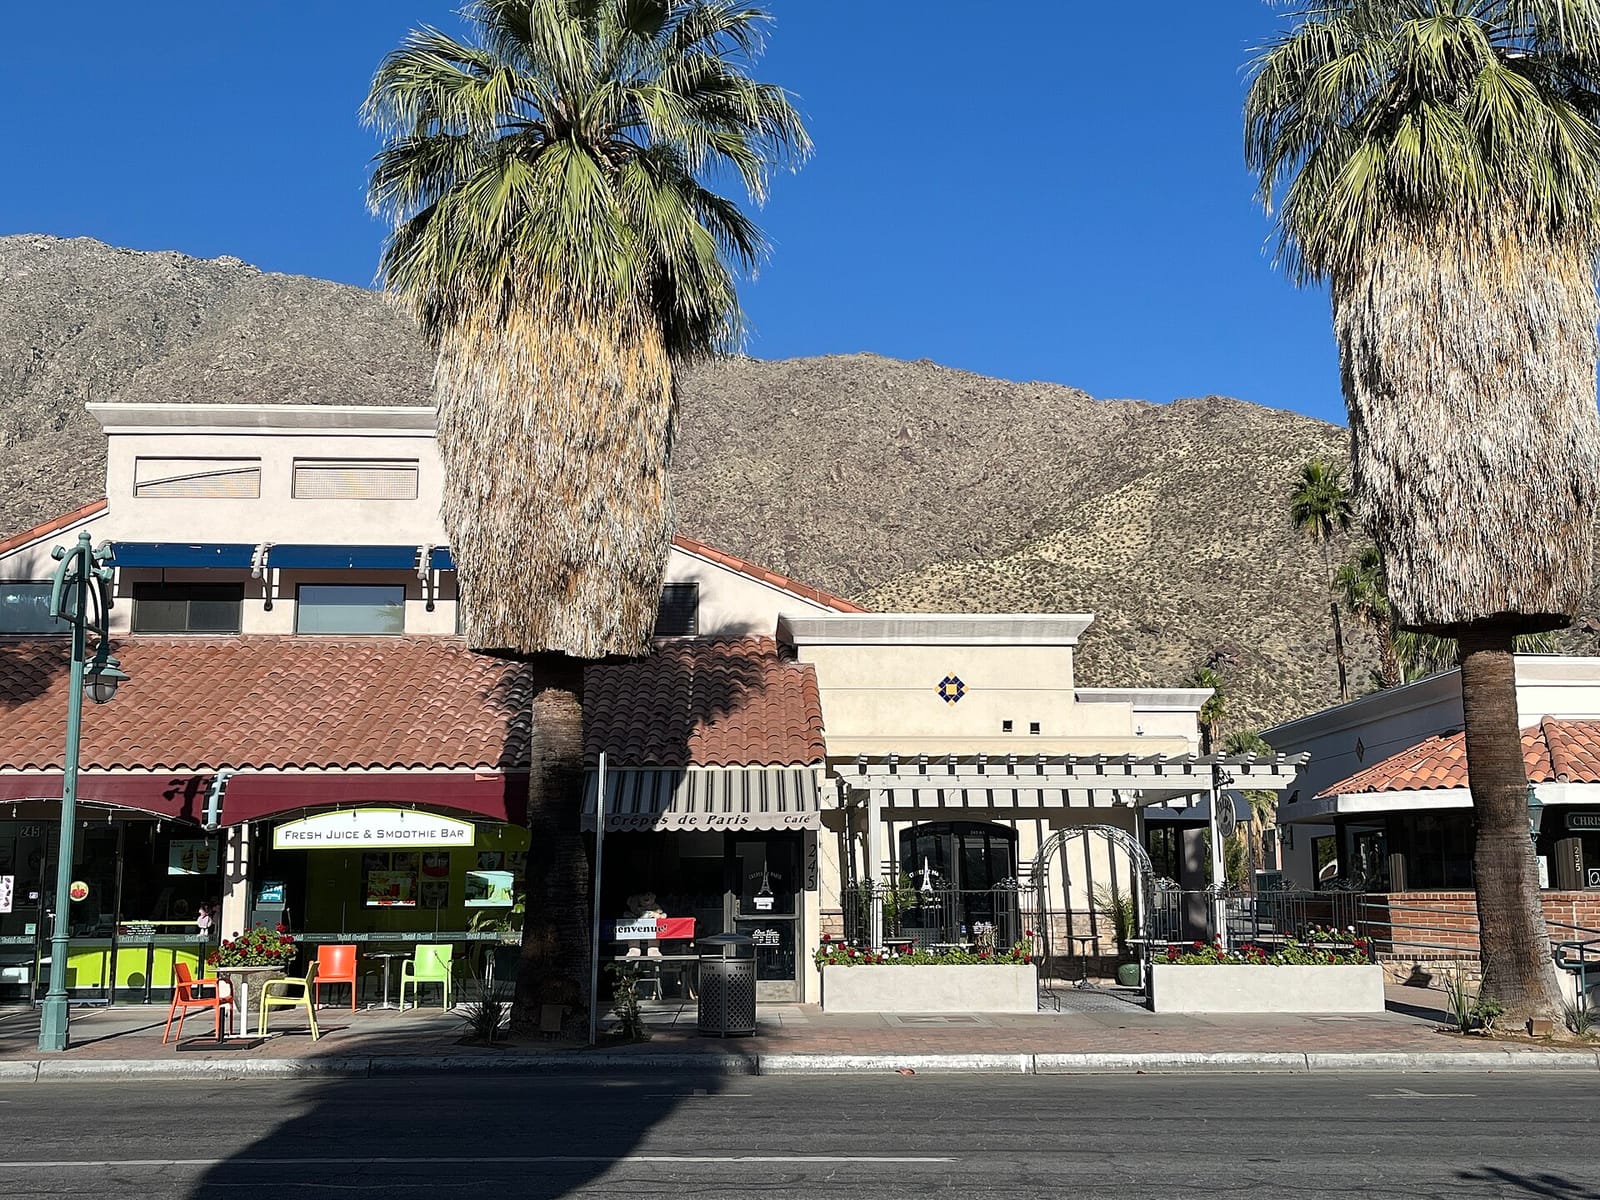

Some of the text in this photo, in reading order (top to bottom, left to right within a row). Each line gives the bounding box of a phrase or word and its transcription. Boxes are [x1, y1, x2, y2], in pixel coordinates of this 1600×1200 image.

[678, 815, 697, 824] de
[707, 815, 750, 825] Paris
[784, 815, 811, 824] Café
[285, 828, 464, 840] FRESH JUICE & SMOOTHIE BAR
[1574, 846, 1582, 872] 235
[808, 844, 817, 889] 245
[1590, 871, 1600, 885] O
[614, 923, 667, 934] ienvenue!
